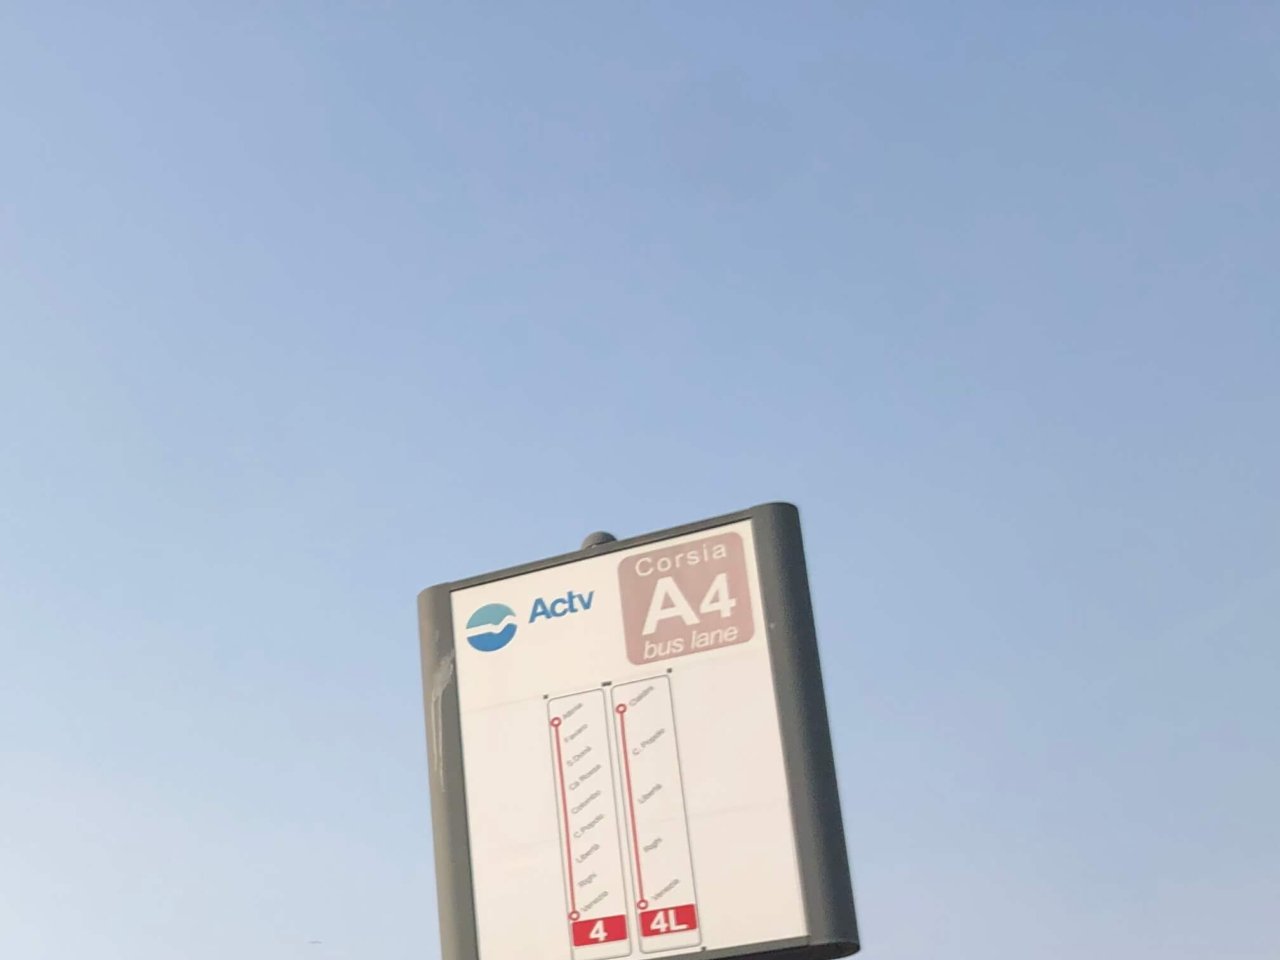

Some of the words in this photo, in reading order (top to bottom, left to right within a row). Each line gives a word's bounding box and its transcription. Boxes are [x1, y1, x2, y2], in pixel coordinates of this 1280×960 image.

[635, 543, 727, 577] Corsia
[528, 590, 595, 624] Actv
[642, 572, 737, 636] A4
[643, 637, 684, 660] bus
[690, 625, 739, 650] lane
[589, 919, 608, 942] 4
[650, 909, 690, 933] 4L
